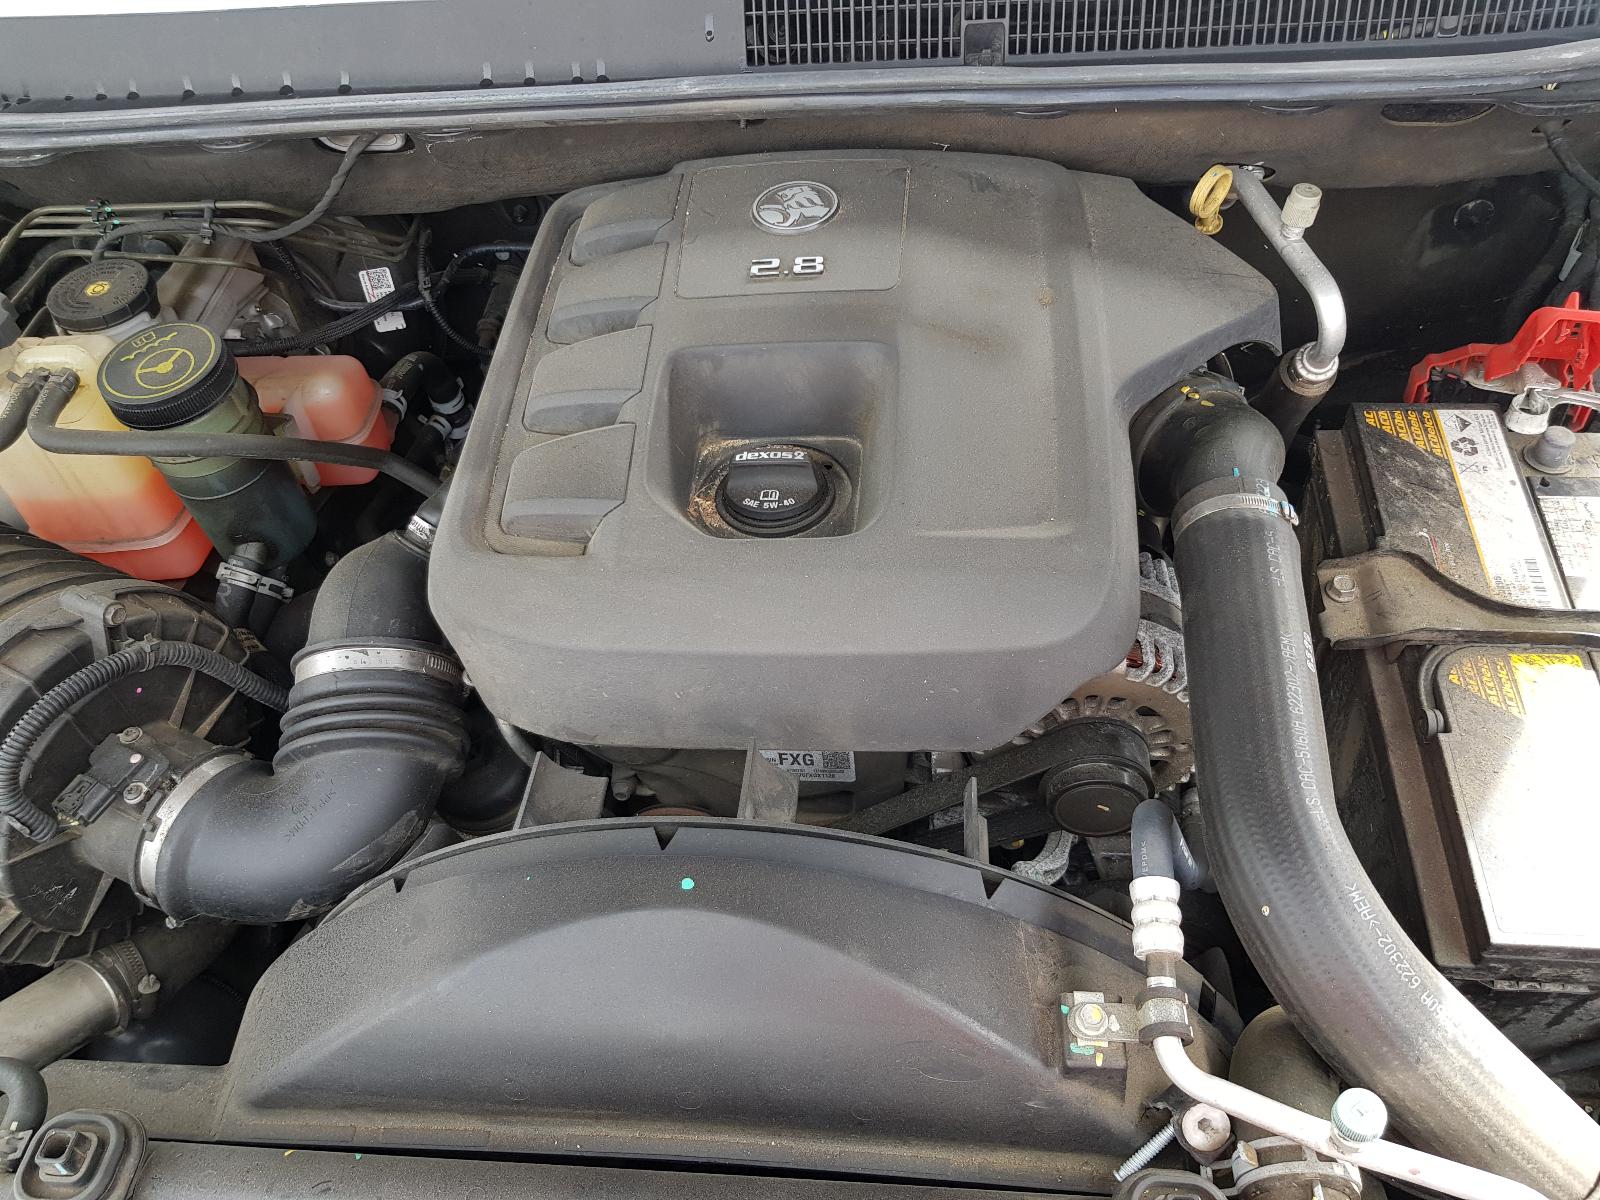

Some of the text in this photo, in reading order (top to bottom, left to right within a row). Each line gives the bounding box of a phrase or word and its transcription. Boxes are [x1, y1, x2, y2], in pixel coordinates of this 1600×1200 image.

[749, 255, 824, 278] 2.8
[735, 451, 805, 461] dexos2
[742, 498, 796, 509] SAE 5W-40
[777, 752, 815, 766] FXG
